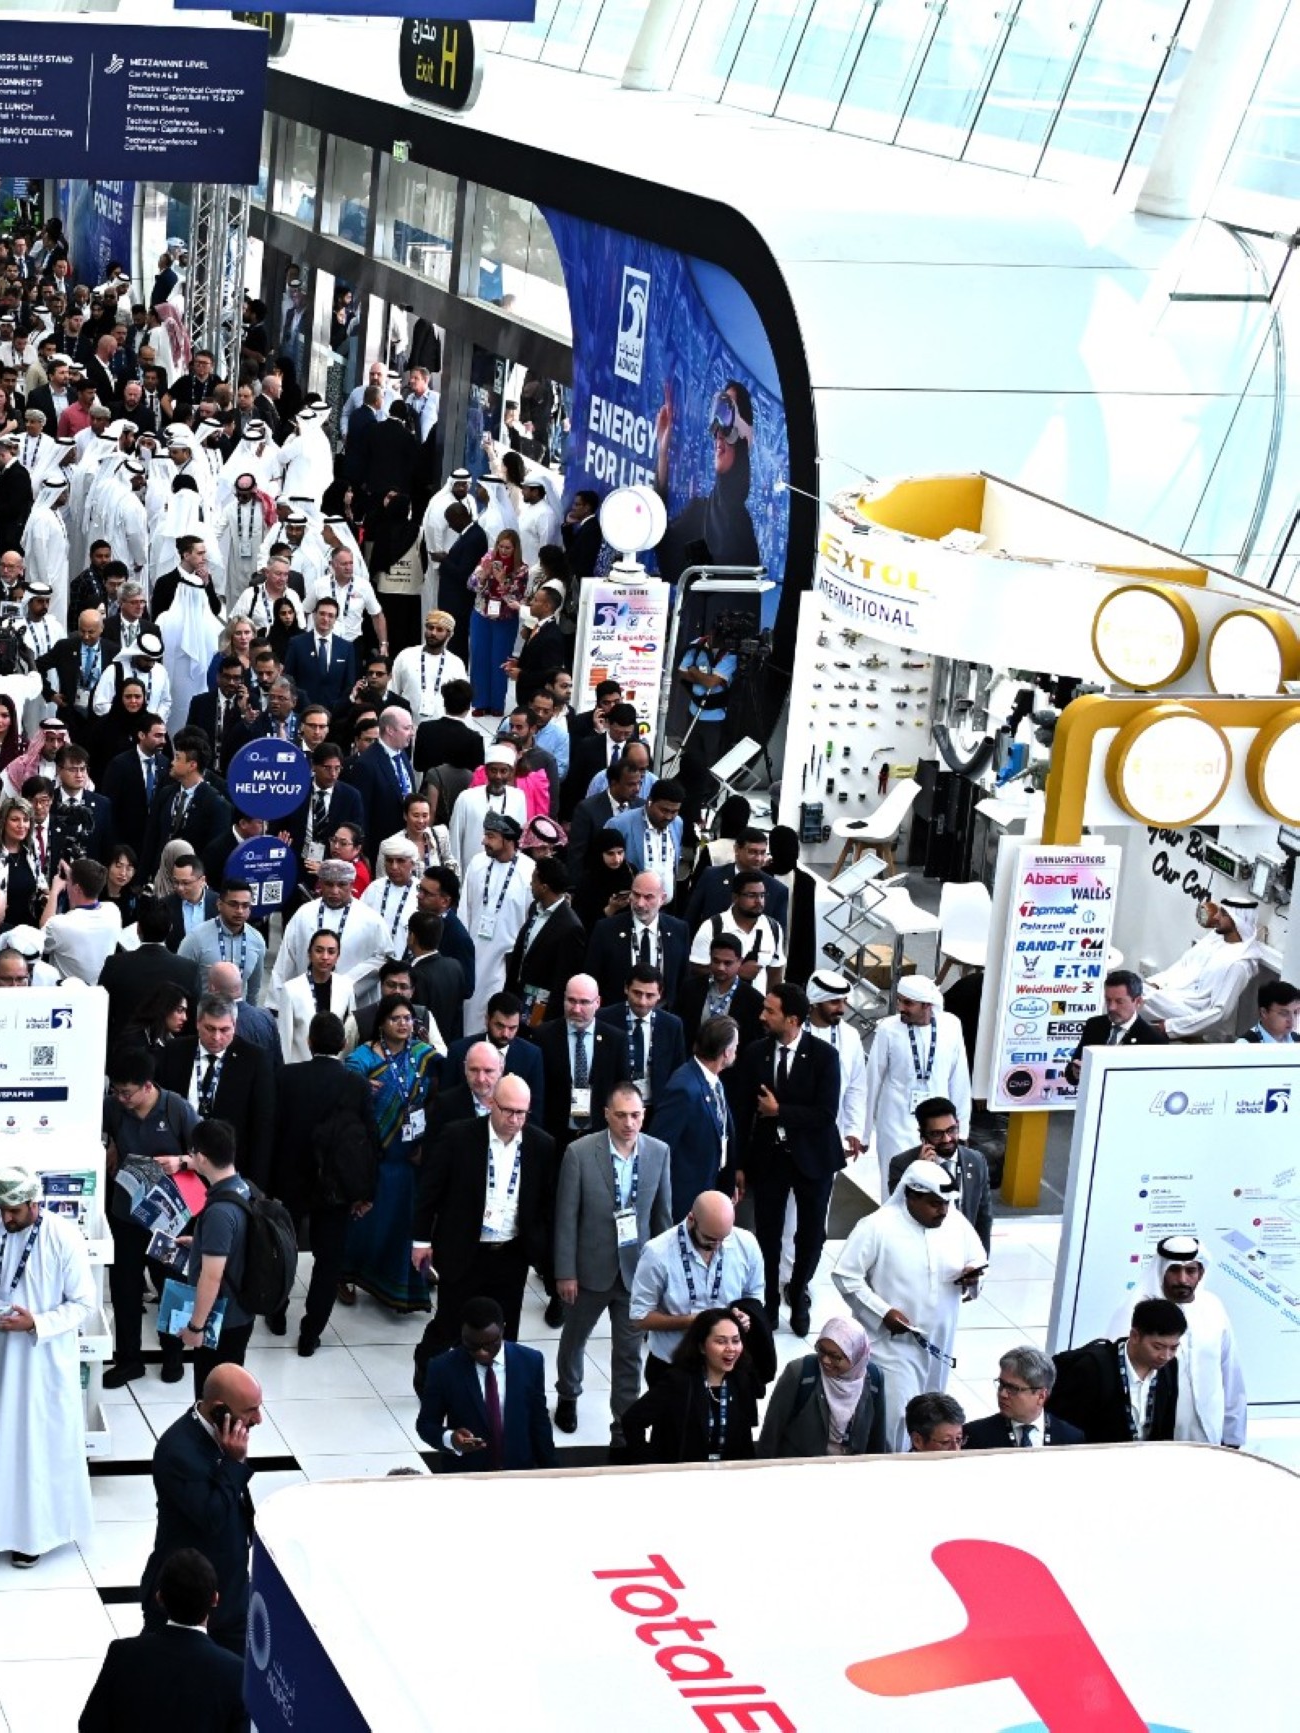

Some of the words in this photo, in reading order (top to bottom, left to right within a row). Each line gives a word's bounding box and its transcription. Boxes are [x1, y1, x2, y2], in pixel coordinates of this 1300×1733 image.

[18, 54, 44, 63] SALES
[45, 55, 74, 64] STAND
[440, 25, 458, 90] H
[185, 60, 209, 69] LEVEL
[416, 54, 434, 84] Exit
[5, 102, 33, 111] LUNCH
[21, 128, 73, 137] COLLECTION
[588, 394, 657, 459] ENERGY
[585, 440, 616, 487] FOR
[253, 770, 280, 781] MAY
[282, 772, 286, 780] I
[235, 783, 267, 794] HELP
[270, 784, 302, 795] YOU?
[1035, 856, 1105, 864] MANUFACTURERS
[1152, 851, 1180, 884] Our
[1024, 872, 1078, 885] Abacus
[1016, 940, 1077, 951] BAND-IT
[1016, 984, 1078, 994] Weidmüller
[1068, 1004, 1096, 1012] TEKAB
[1048, 1022, 1087, 1035] ERCO
[1010, 1052, 1048, 1062] EMI
